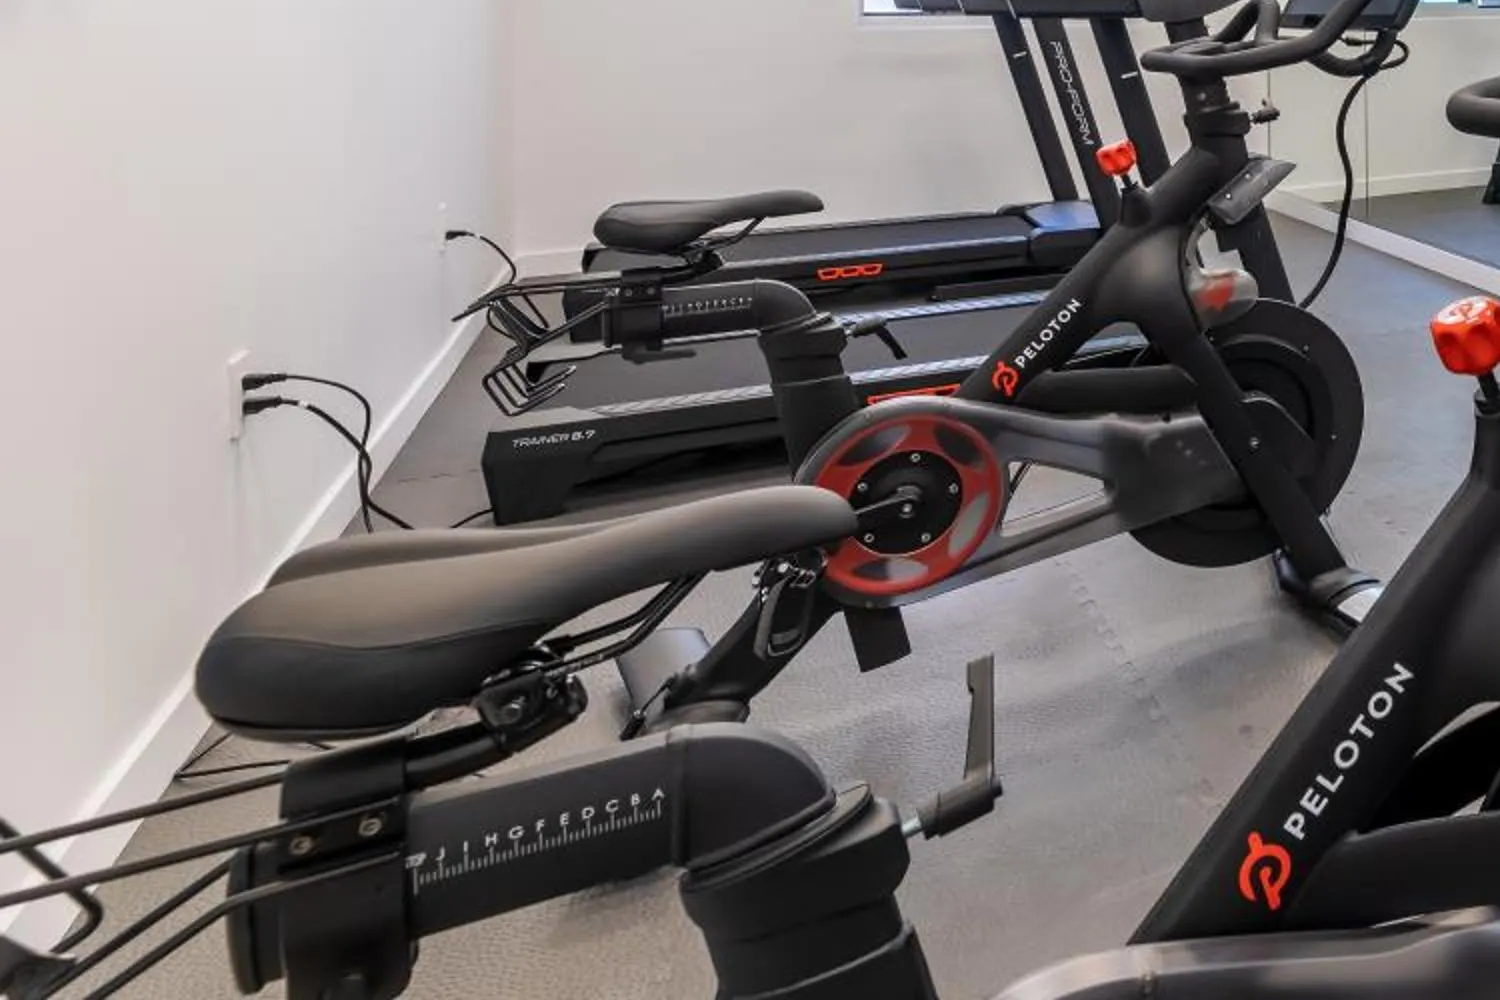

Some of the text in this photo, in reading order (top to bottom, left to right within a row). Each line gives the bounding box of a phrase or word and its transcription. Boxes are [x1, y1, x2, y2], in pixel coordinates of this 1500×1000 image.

[1014, 298, 1082, 369] PELOTON
[512, 433, 570, 449] TRAINER
[1283, 662, 1415, 840] PELOTON
